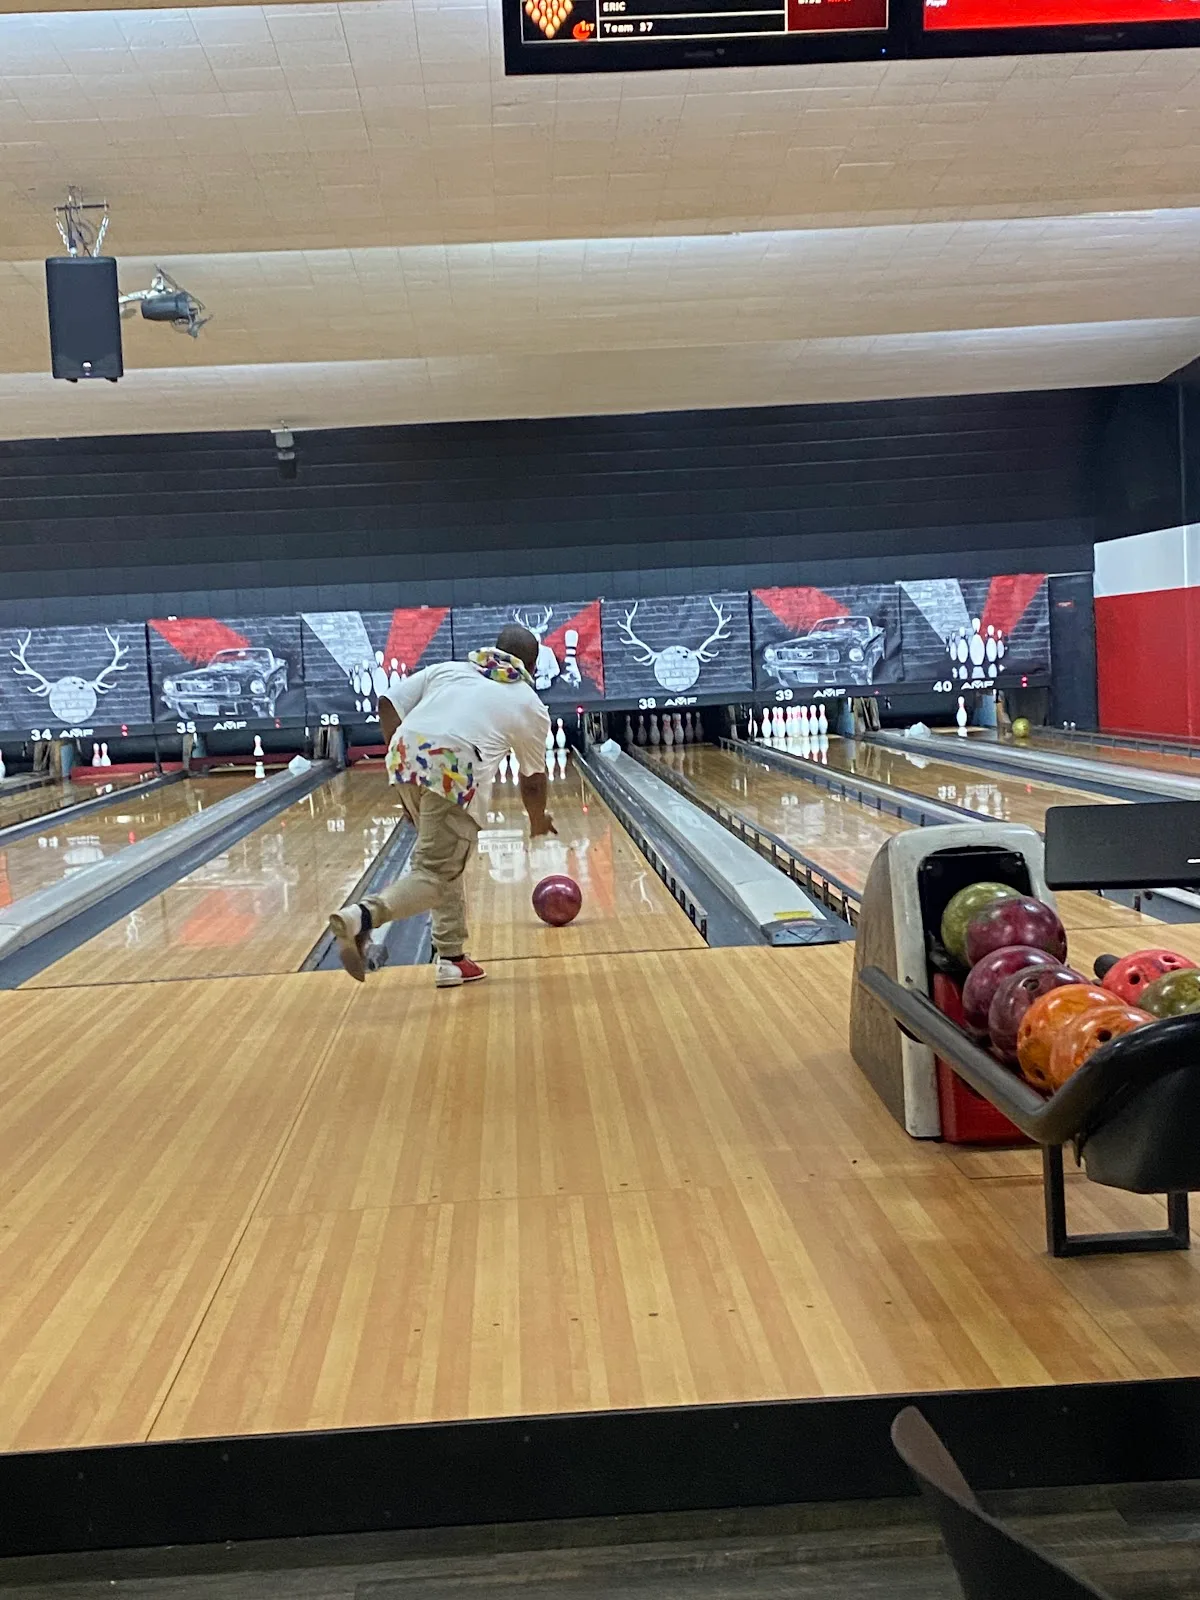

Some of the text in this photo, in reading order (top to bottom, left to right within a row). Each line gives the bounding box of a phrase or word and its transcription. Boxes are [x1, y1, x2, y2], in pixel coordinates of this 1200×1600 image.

[603, 1, 625, 12] ERIC
[604, 22, 633, 33] Team
[933, 680, 994, 692] 40 AMF
[775, 688, 846, 701] 39 AMF
[639, 697, 697, 710] 38 AMF
[320, 714, 340, 726] 36
[176, 720, 247, 734] 35 AMF
[31, 728, 94, 741] 34 AMF
